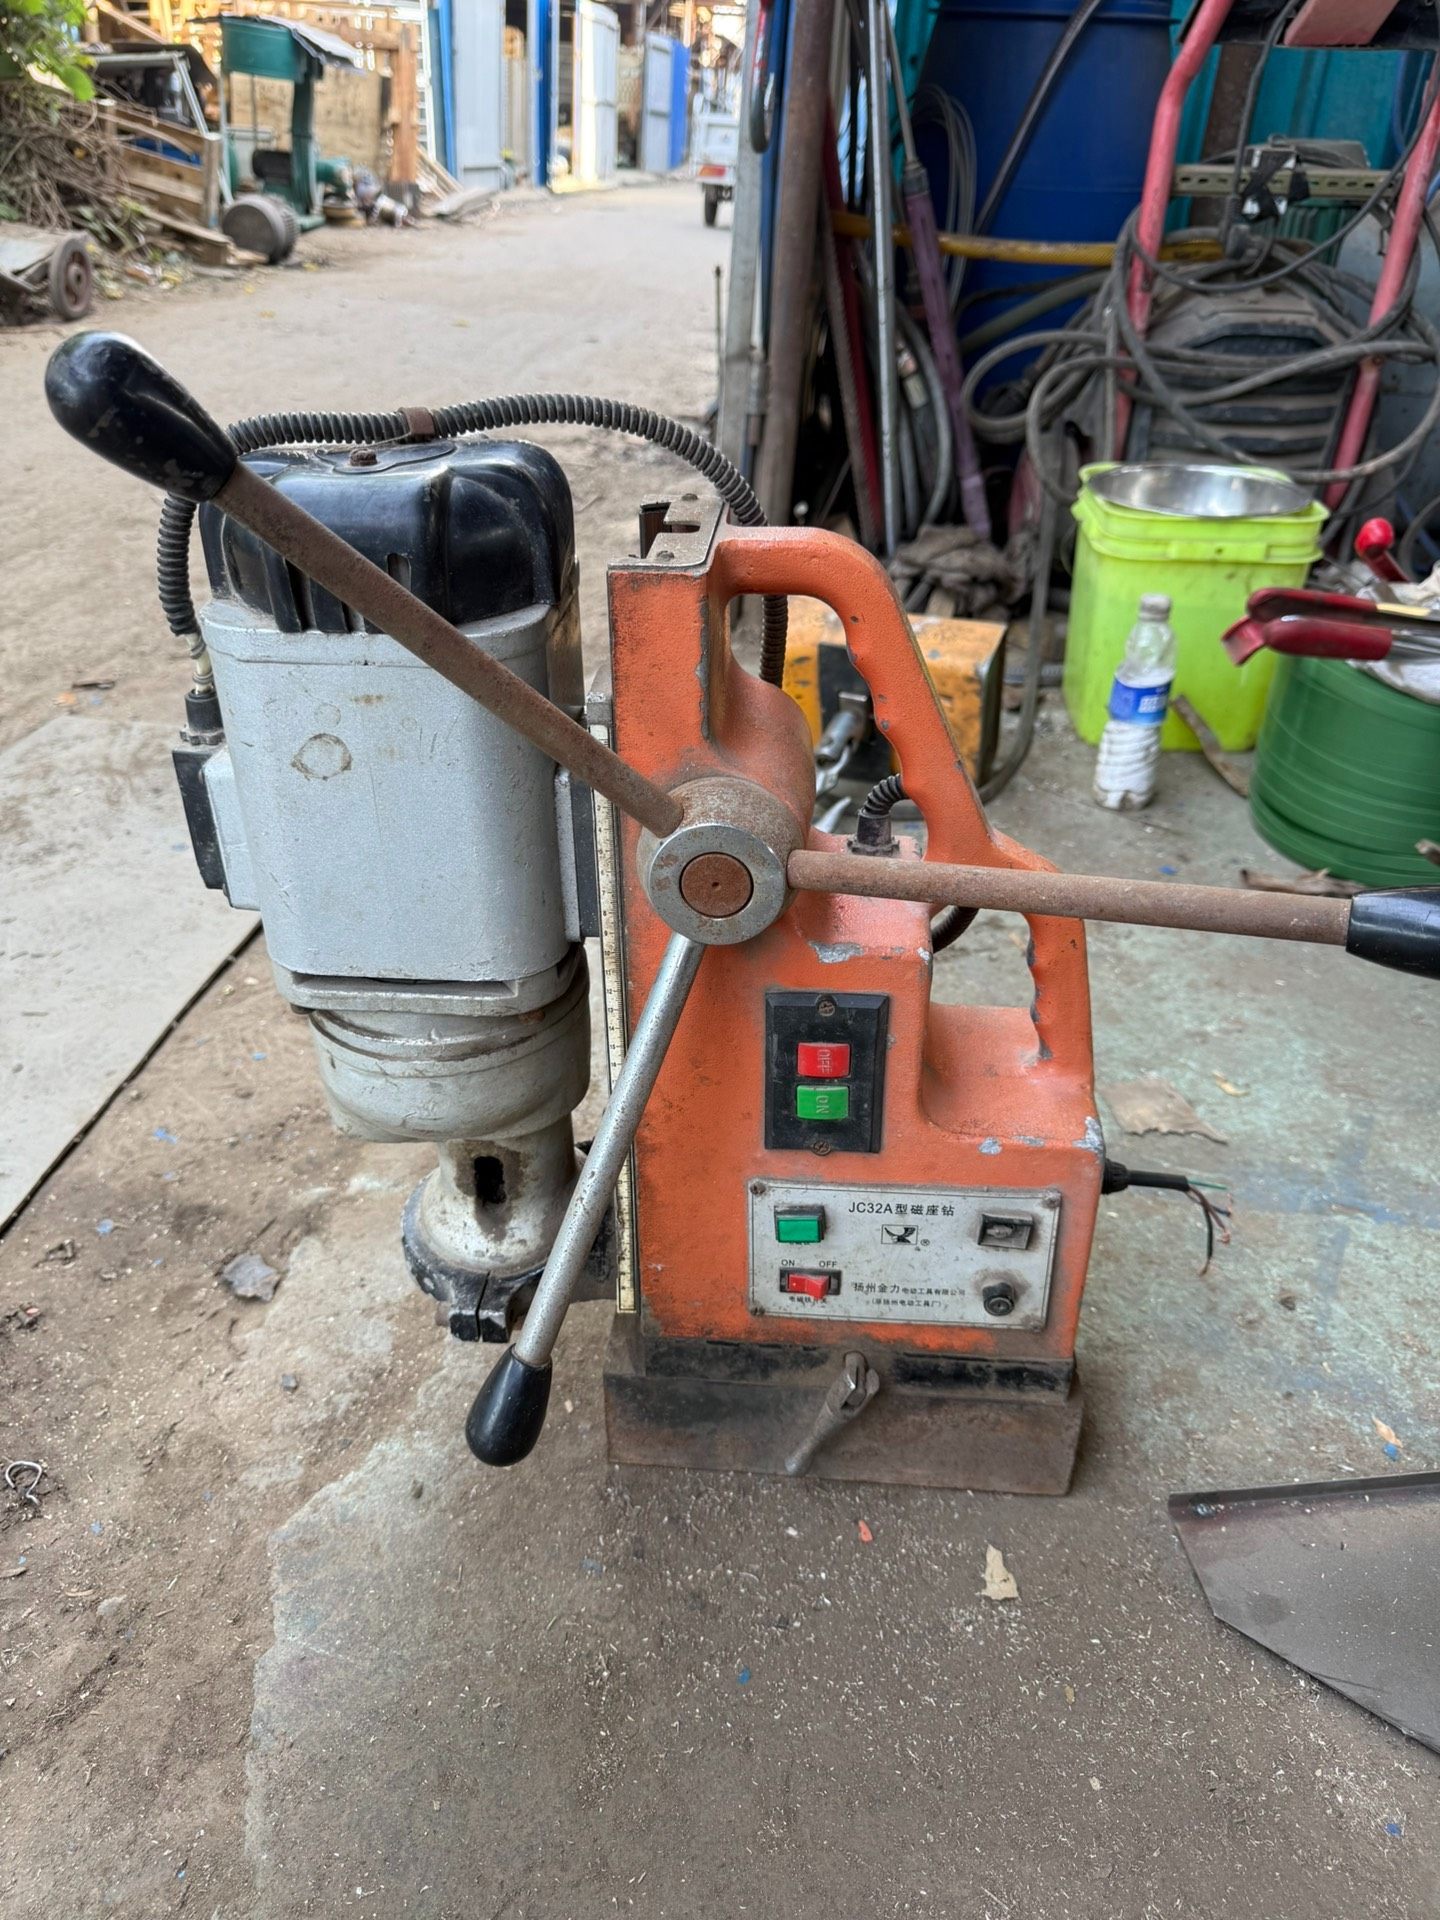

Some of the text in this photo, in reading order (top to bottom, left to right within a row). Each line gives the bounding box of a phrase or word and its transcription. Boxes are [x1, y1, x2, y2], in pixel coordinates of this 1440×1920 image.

[817, 1049, 832, 1074] OFF
[815, 1095, 830, 1114] ON
[848, 1202, 955, 1216] JC32A型磁座钻
[781, 1259, 837, 1268] ON OFF
